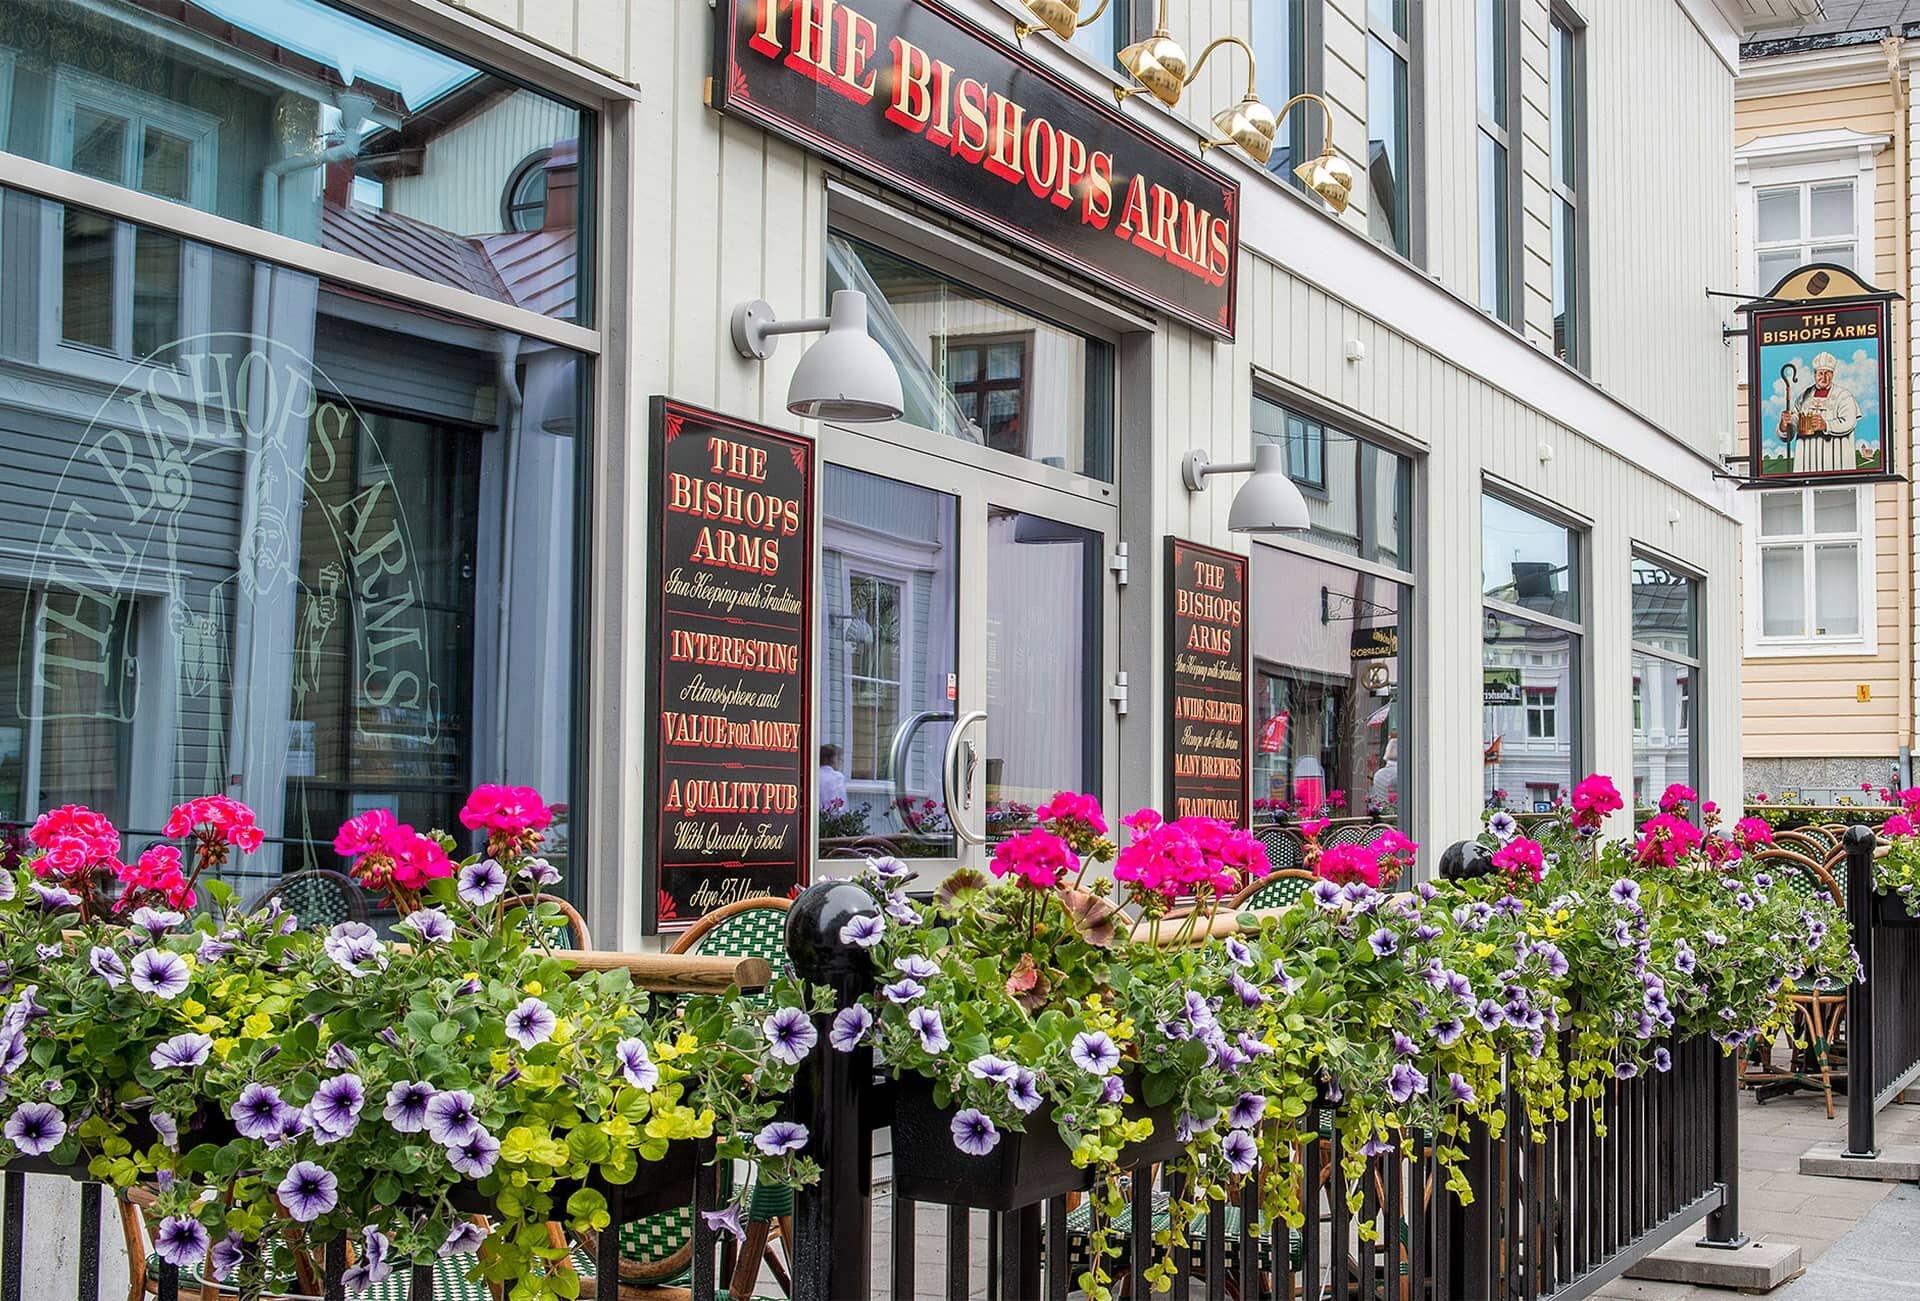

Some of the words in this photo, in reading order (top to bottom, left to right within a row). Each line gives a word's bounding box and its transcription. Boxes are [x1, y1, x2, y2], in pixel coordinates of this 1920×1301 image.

[749, 0, 877, 105] THE
[886, 36, 1113, 229] BISHOPS
[1115, 173, 1230, 287] ARMS
[1763, 327, 1831, 344] BISHOPS
[1834, 324, 1877, 337] ARMS
[1802, 314, 1837, 327] THE
[84, 350, 349, 527] BISHOPS
[707, 436, 768, 484] THE
[668, 472, 799, 536] BISHOPS
[690, 526, 779, 576] ARMS
[34, 501, 137, 690] THE
[328, 480, 424, 711] ARMS
[664, 567, 691, 597] Inn
[689, 571, 738, 612] Keeping
[736, 582, 761, 608] with
[761, 583, 801, 615] Tradition
[1193, 561, 1225, 592] THE
[1176, 588, 1241, 627] BISHOPS
[670, 630, 798, 673] INTERESTING
[1185, 624, 1232, 656] ARMS
[680, 673, 757, 712] Atmosphere
[756, 683, 785, 709] and
[1175, 696, 1183, 719] A
[1183, 696, 1205, 720] WIDE
[1205, 699, 1243, 725] SELECTED
[662, 712, 727, 748] VALUE
[750, 720, 800, 752] MONEY
[1175, 754, 1201, 777] MANY
[1201, 755, 1241, 780] BREWERS
[664, 779, 682, 811] A
[684, 779, 762, 816] QUALITY
[762, 783, 798, 814] PUB
[1178, 798, 1240, 819] TRADITIONAL
[674, 821, 705, 850] With
[702, 822, 753, 857] Quality
[754, 823, 789, 850] Food
[690, 879, 719, 915] Age
[718, 879, 739, 906] 23
